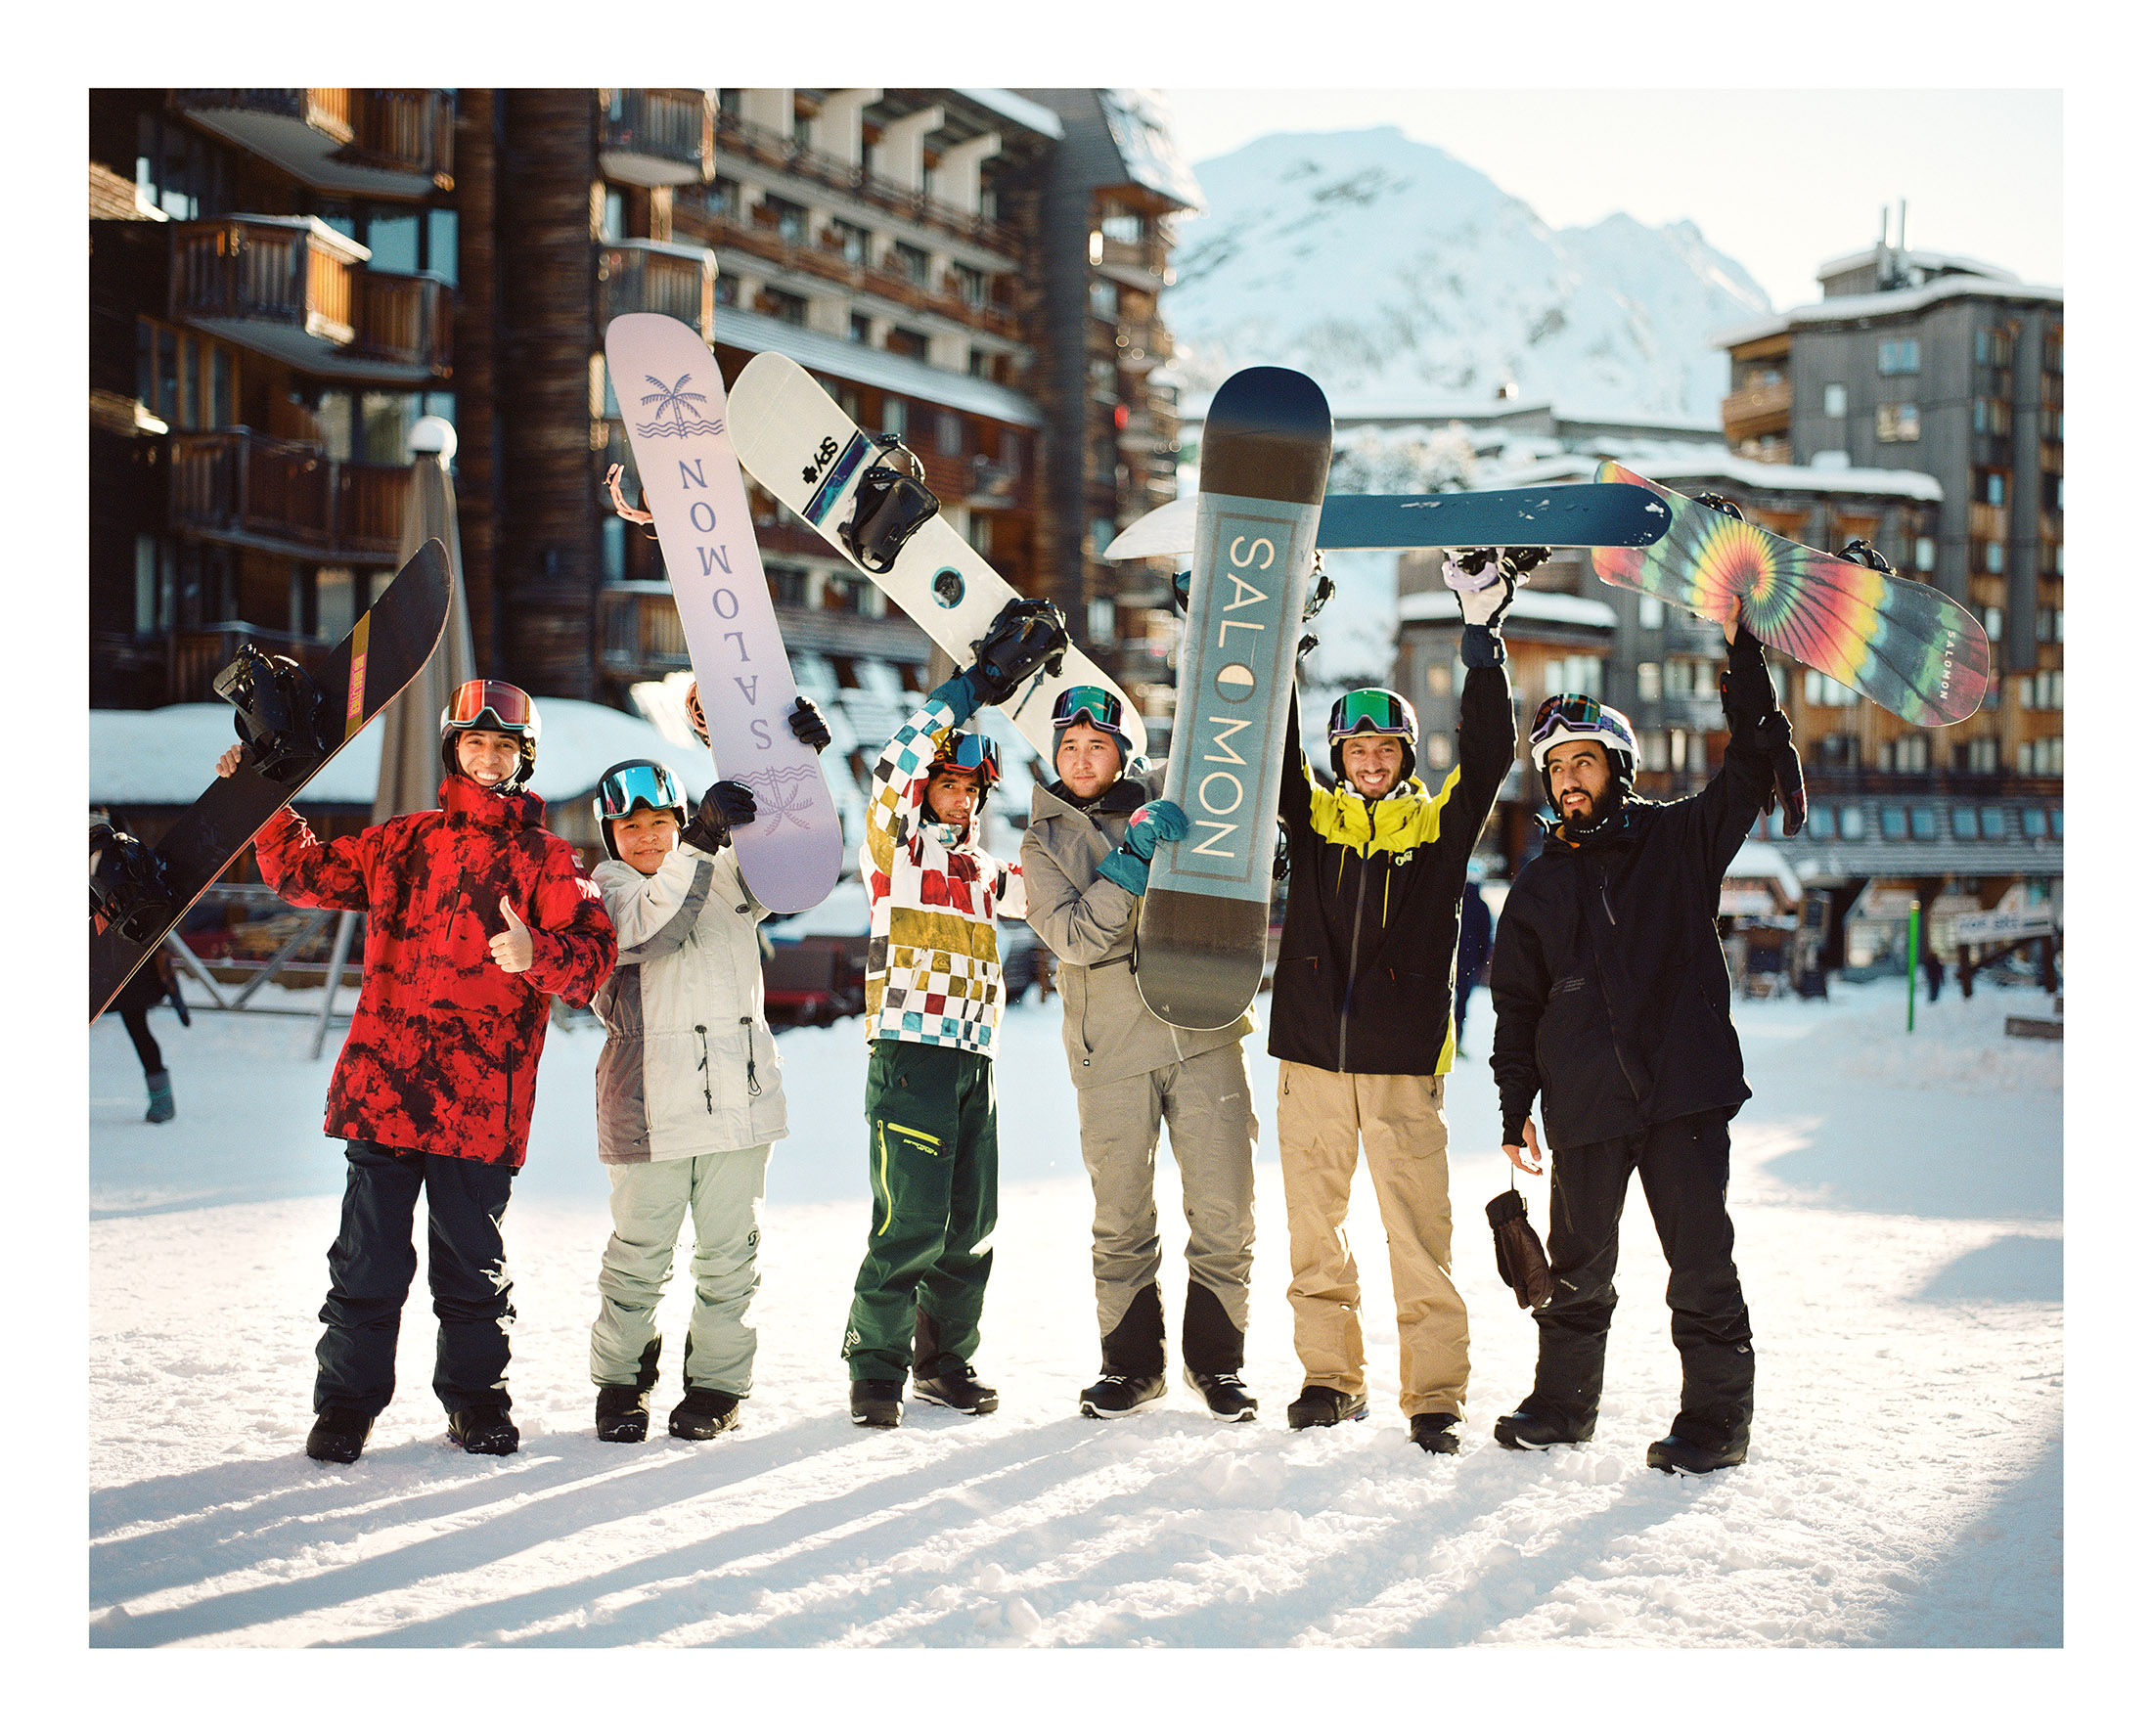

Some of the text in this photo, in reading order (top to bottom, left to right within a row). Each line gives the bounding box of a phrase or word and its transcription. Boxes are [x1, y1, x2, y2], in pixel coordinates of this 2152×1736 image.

[679, 458, 773, 750] SALOMON
[1190, 535, 1276, 859] SALOMON
[1940, 630, 1957, 700] SALOMON
